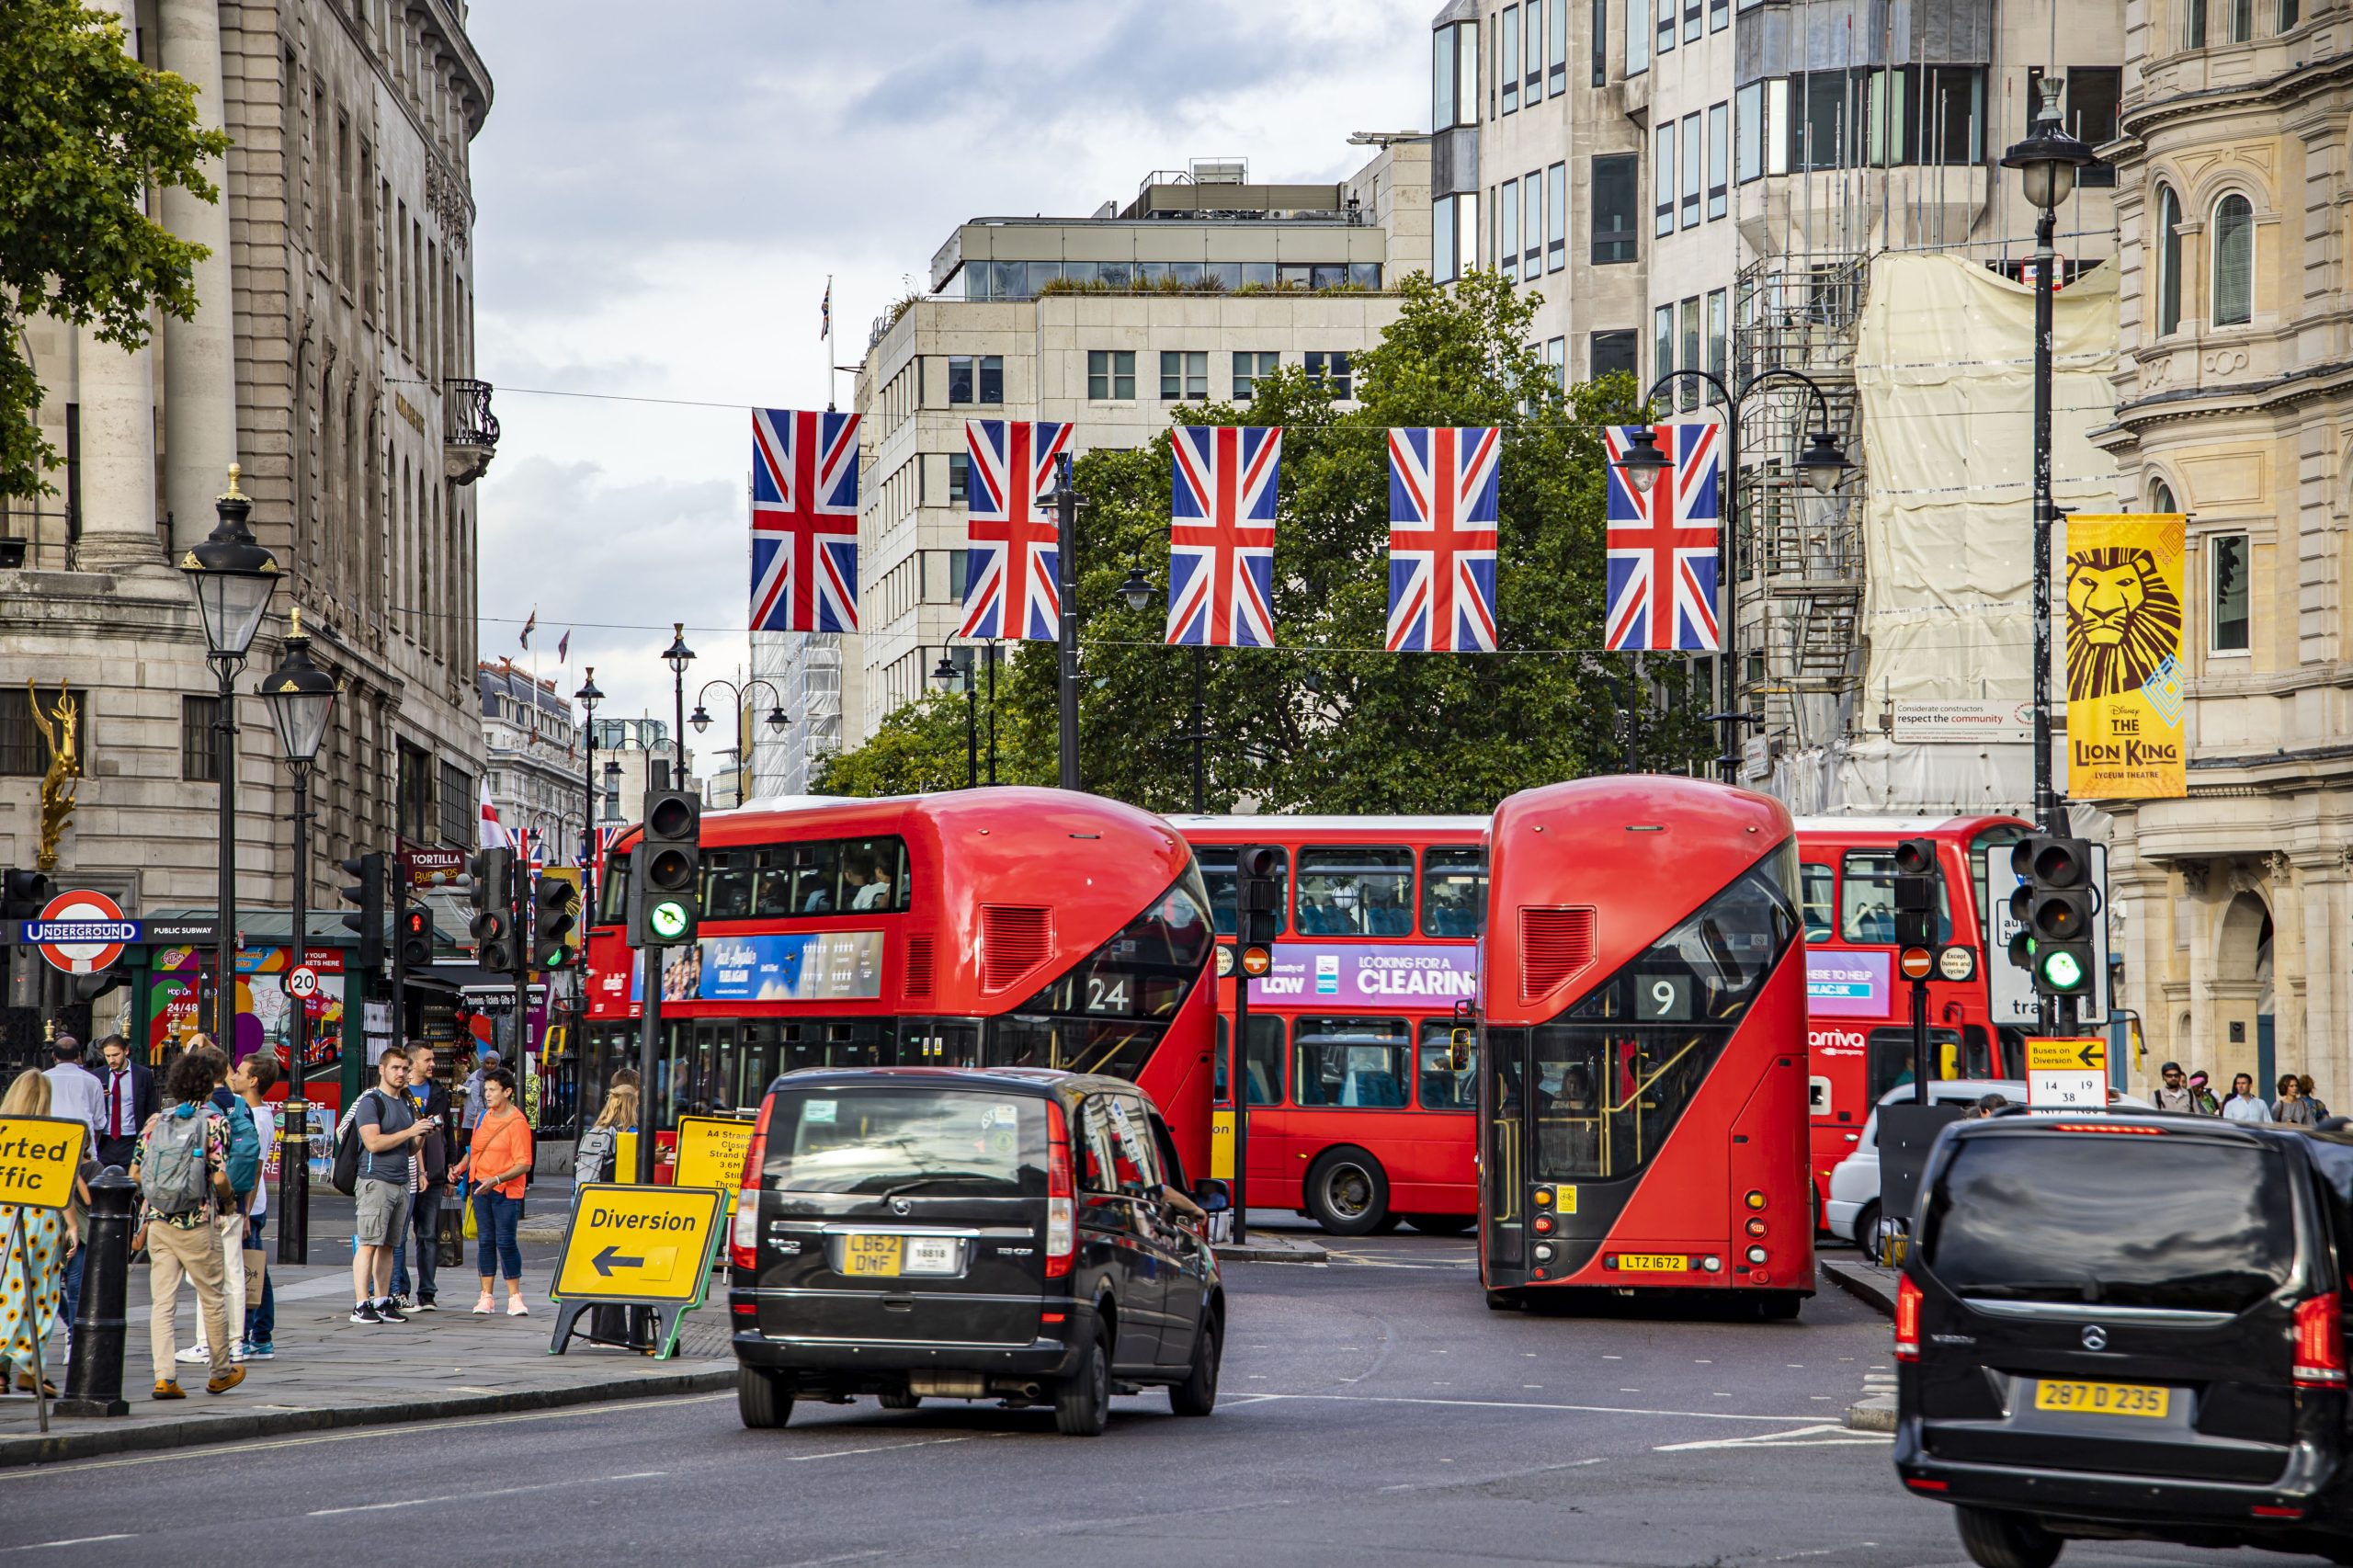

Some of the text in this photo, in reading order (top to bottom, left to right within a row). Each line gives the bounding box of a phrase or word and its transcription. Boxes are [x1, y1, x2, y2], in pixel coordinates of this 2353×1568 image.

[1898, 714, 2003, 724] respect the community
[2111, 719, 2139, 731] THE
[411, 854, 460, 864] TORTILLA
[28, 924, 136, 940] UNDERGROUND
[1358, 956, 1451, 969] LOOKING FOR A
[294, 975, 314, 989] 20
[182, 988, 191, 996] On
[1088, 978, 1129, 1011] 24
[1653, 980, 1675, 1015] 9
[1808, 1028, 1865, 1047] arriva
[2046, 1081, 2092, 1090] 14 19
[2062, 1093, 2075, 1102] 38
[0, 1137, 68, 1162] rted
[710, 1150, 739, 1159] Strand
[590, 1208, 696, 1231] Diversion
[850, 1236, 898, 1252] LB62
[855, 1255, 890, 1271] DNF
[1627, 1257, 1680, 1268] LTZ 1672
[2045, 1384, 2161, 1410] 287 D 235
